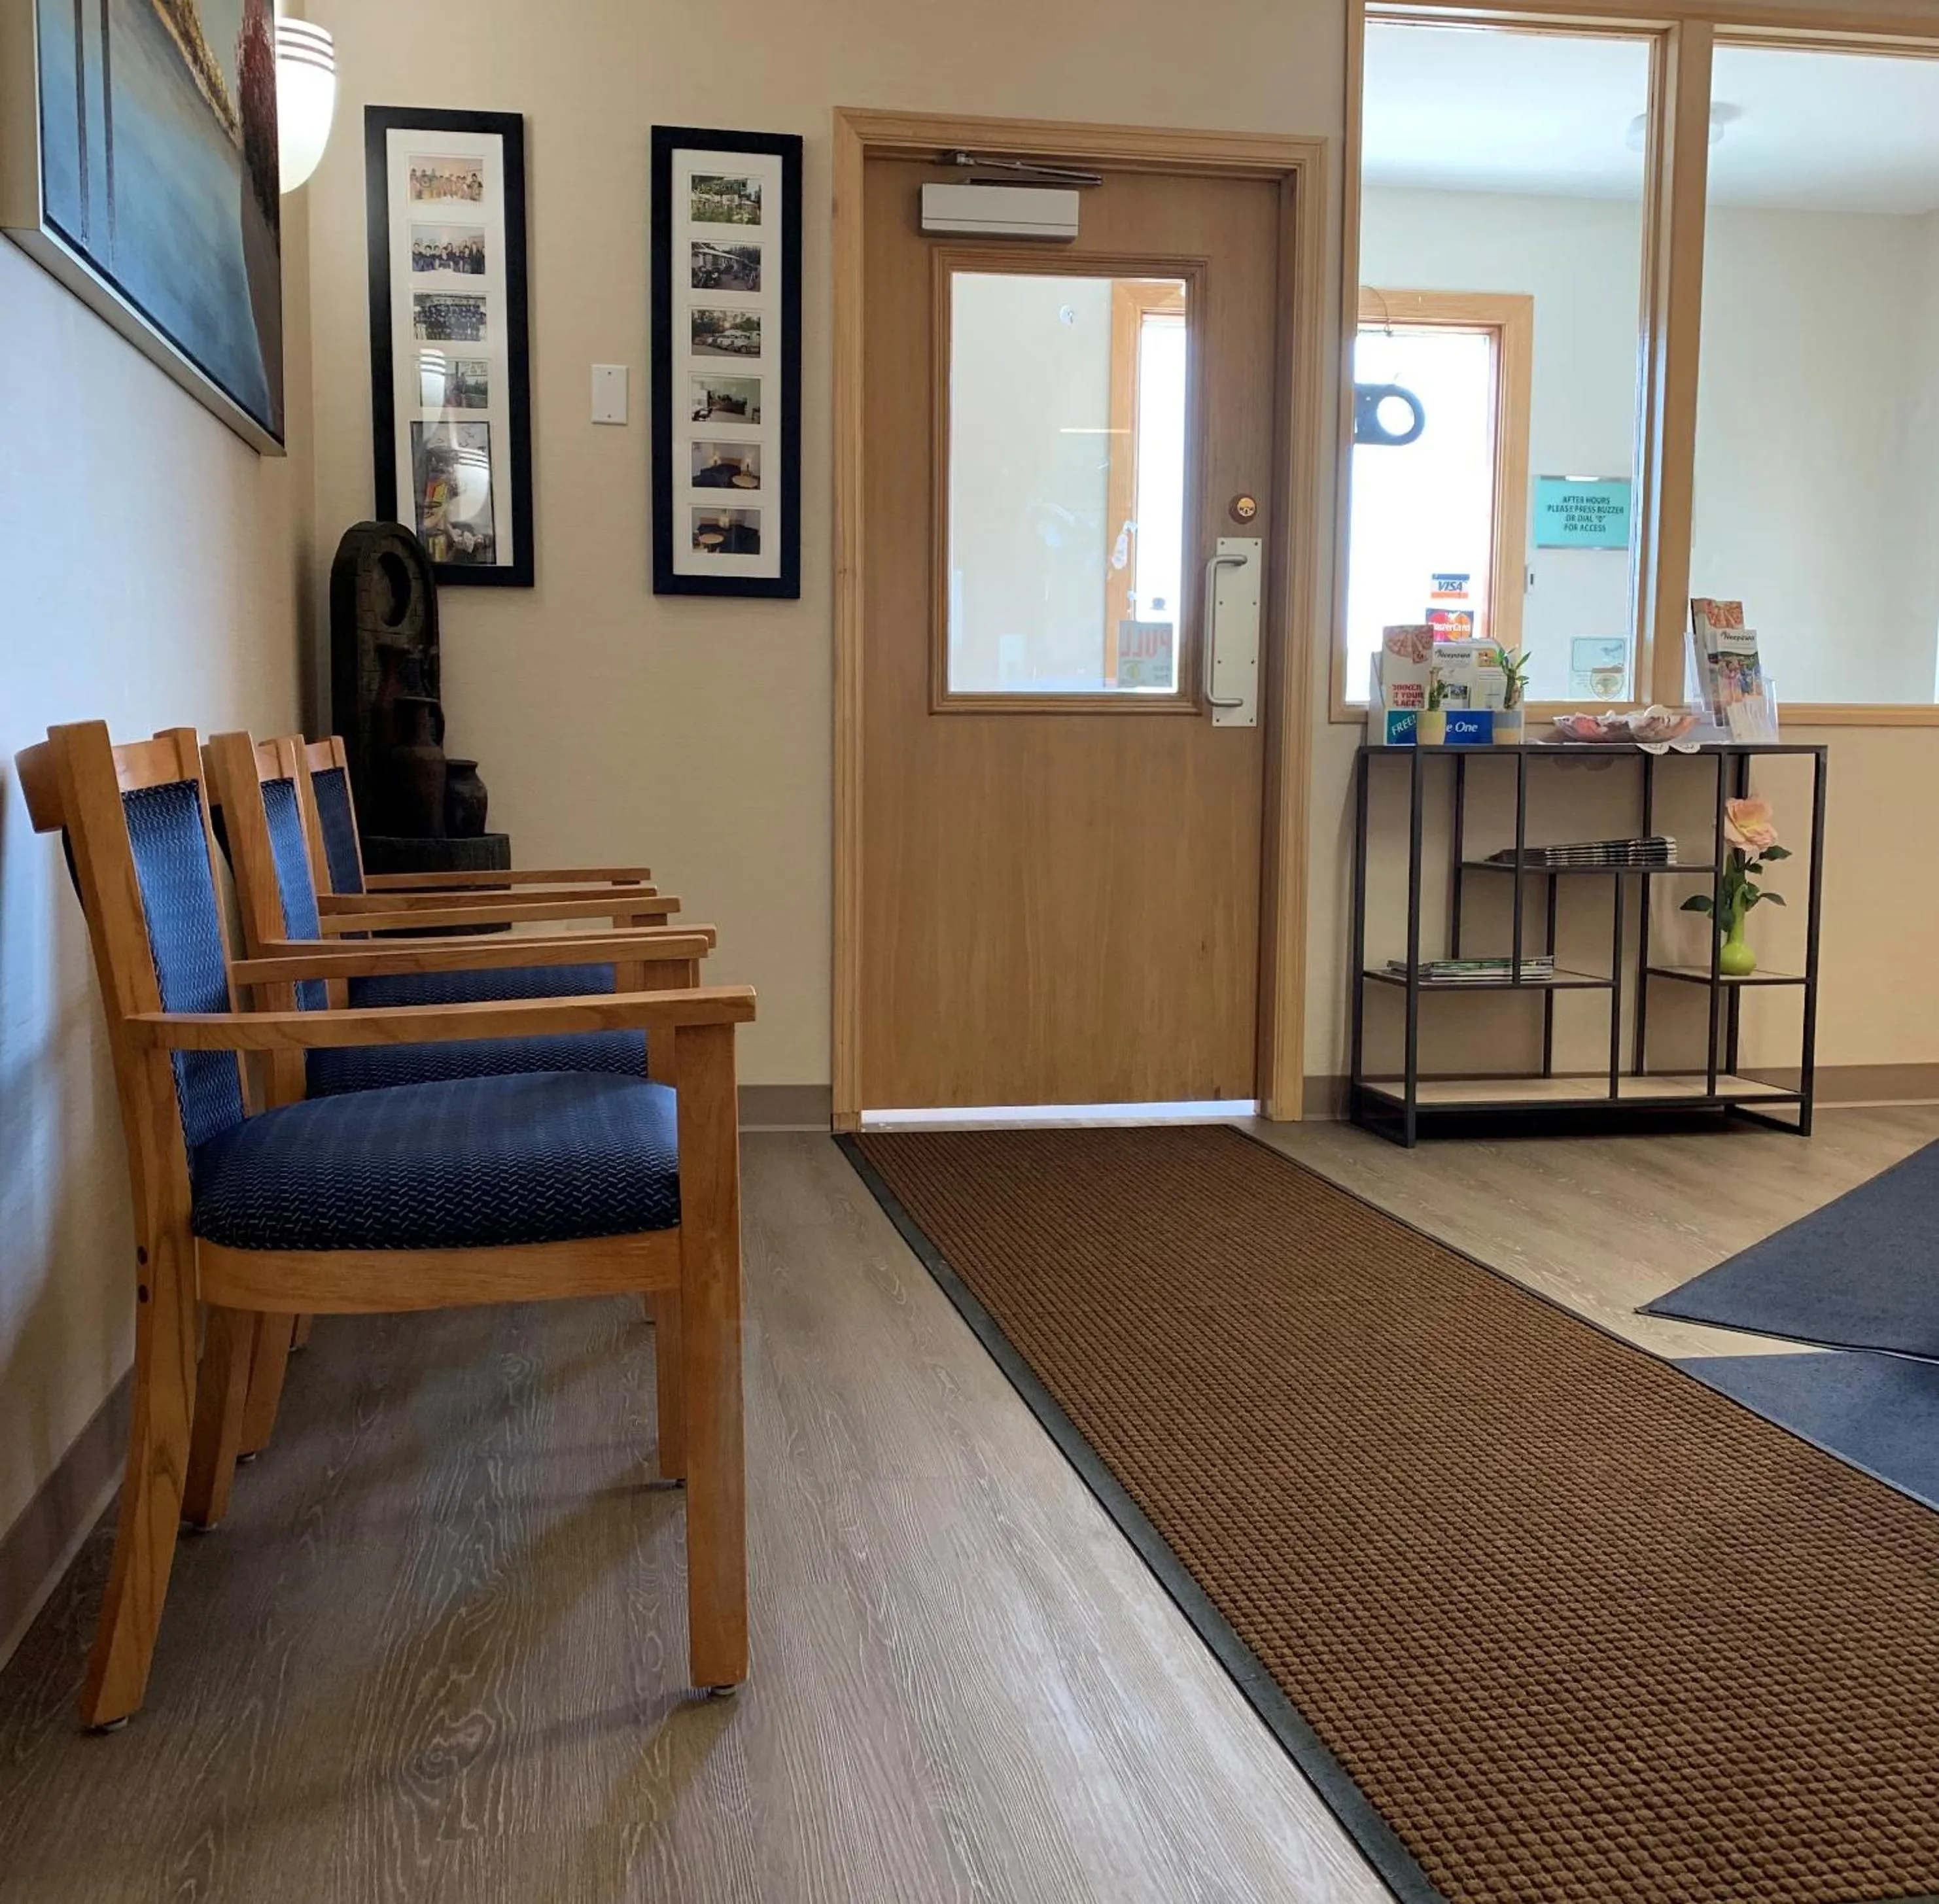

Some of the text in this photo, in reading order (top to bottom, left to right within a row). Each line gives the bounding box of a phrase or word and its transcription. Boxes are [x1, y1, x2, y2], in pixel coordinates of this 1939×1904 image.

[1562, 496, 1611, 505] AFTER HOURS
[1546, 504, 1624, 514] PLEASE PRESS BUZZER
[1563, 523, 1606, 532] FOR ACCESS
[1438, 581, 1463, 591] VISA
[1391, 714, 1416, 736] FREE!
[1455, 721, 1478, 733] One
